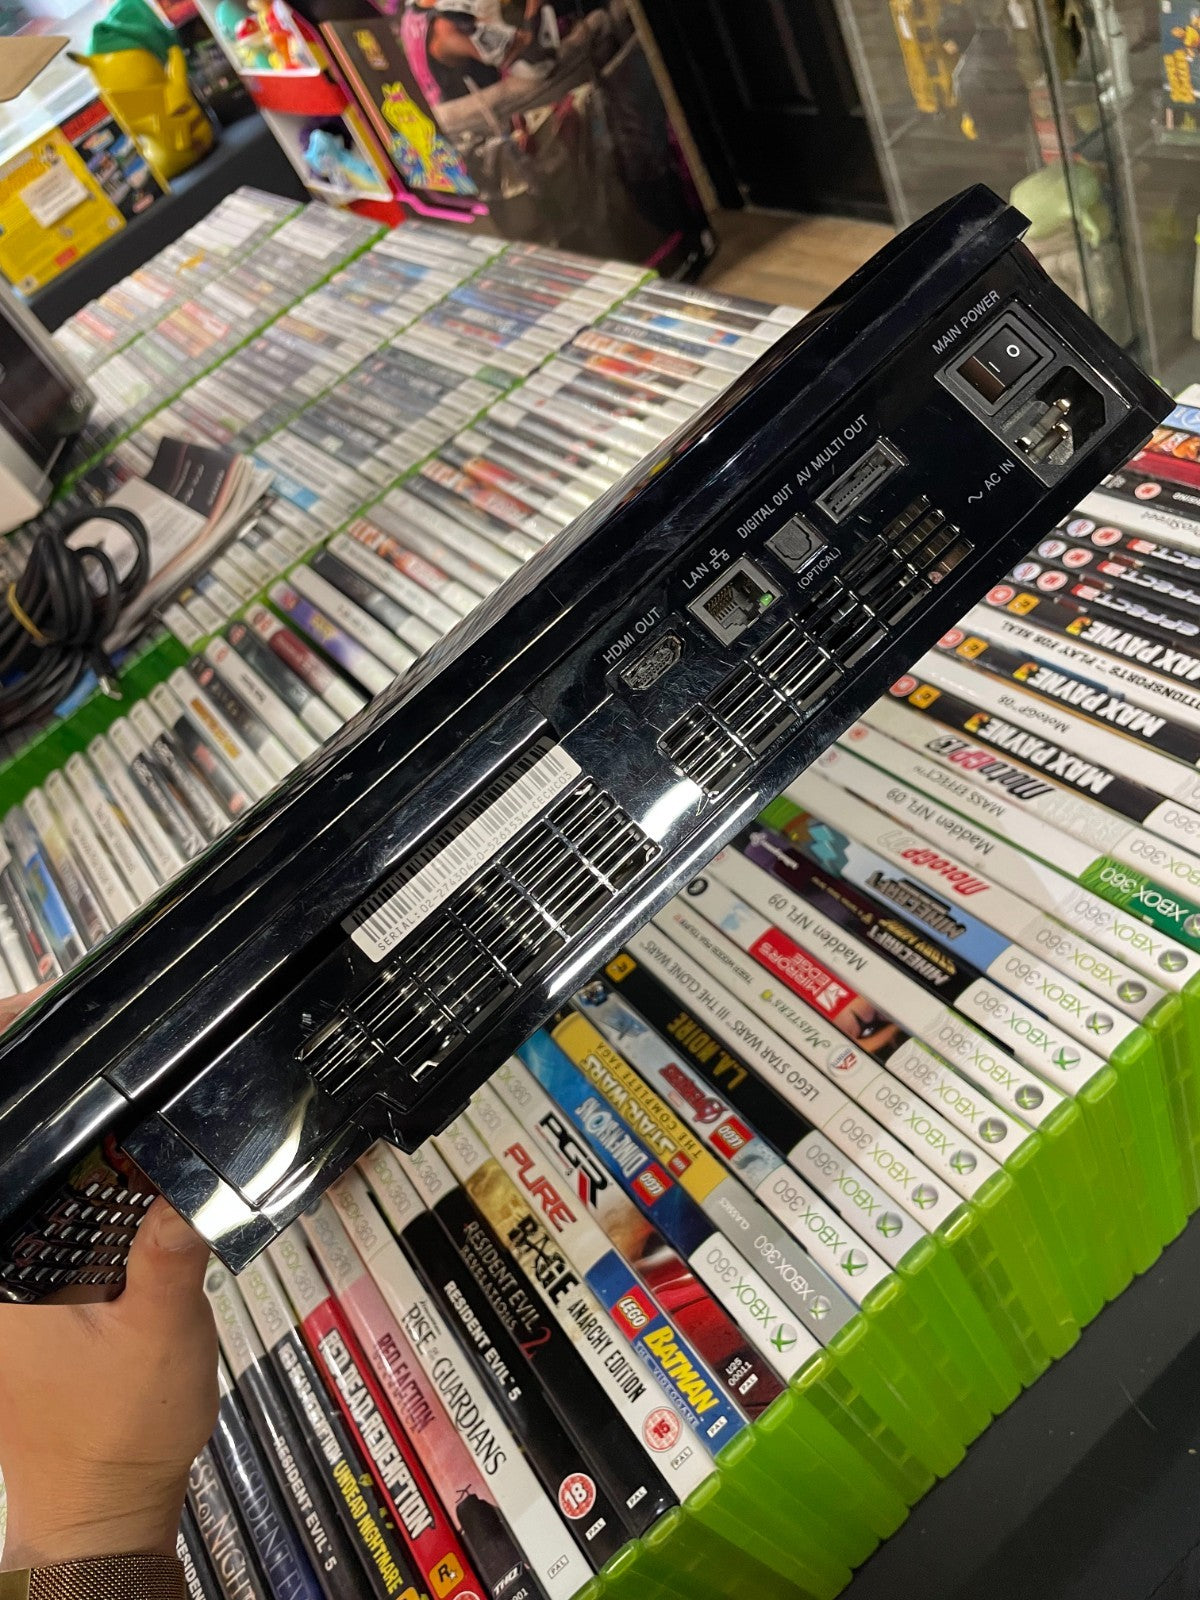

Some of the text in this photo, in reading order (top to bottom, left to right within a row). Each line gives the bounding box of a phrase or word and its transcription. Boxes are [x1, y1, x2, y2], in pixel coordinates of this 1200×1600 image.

[932, 290, 1000, 355] MAIN POWER
[796, 414, 868, 486] AV MULTI OUT
[983, 458, 1016, 492] AC IN
[737, 483, 794, 540] DIGITAL OUT
[682, 562, 710, 589] LAN
[797, 547, 842, 590] (OPTICAL)
[602, 607, 660, 664] HDMI OUT
[1064, 612, 1092, 636] 3
[1079, 619, 1163, 662] PAYNE
[1011, 658, 1166, 737] MAX PAYNE 3
[962, 710, 1115, 794] MAX PAYNE 3
[885, 785, 995, 856] Madden NFL 09
[967, 789, 1006, 818] MASS
[1127, 838, 1168, 867] 360
[767, 890, 788, 911] 09
[785, 904, 814, 930] NFL
[864, 868, 966, 944] MINECRAFT
[1097, 865, 1188, 925] XBOX 360
[810, 922, 868, 973] Madden
[865, 924, 949, 988] MINECRAFT
[1034, 926, 1122, 988] XBOX 360
[1072, 898, 1162, 958] XBOX 360
[666, 961, 702, 994] CLONE
[695, 988, 719, 1011] THE
[756, 940, 821, 996] MIRROR'S
[790, 950, 831, 987] EDGE
[1003, 956, 1090, 1019] XBOX 360
[715, 1005, 730, 1021] III
[971, 988, 1057, 1054] XBOX 360
[594, 1040, 622, 1070] SAGA
[665, 1010, 748, 1092] L.A. NOIRE
[759, 1045, 790, 1076] STAR
[937, 1023, 1020, 1092] XBOX 360
[577, 1053, 676, 1158] STAR WARS
[622, 1069, 678, 1131] COMPLETE
[785, 1068, 820, 1102] LEGO
[902, 1054, 982, 1123] XBOX 360
[573, 1095, 663, 1197] LEGO DIMENSIONS
[676, 1131, 702, 1158] THE
[716, 1121, 746, 1151] LEGO
[873, 1085, 953, 1154] XBOX 360
[539, 1111, 610, 1208] PGR
[802, 1143, 881, 1217] XBOX 360
[837, 1117, 916, 1188] XBOX 360
[501, 1142, 576, 1232] PURE
[770, 1177, 846, 1254] XBOX 360
[717, 1195, 814, 1301] XBOX 360 CLASSICS
[462, 1220, 553, 1359] RESIDENT EVIL 2
[507, 1214, 581, 1305] RAGE
[566, 1298, 613, 1354] ANARCHY
[603, 1350, 646, 1403] EDITION
[704, 1247, 778, 1328] XBOX 360
[317, 1329, 351, 1374] RED
[441, 1280, 491, 1349] RESIDENT
[506, 1386, 522, 1402] 5
[618, 1296, 719, 1414] LEGO BATMAN
[333, 1366, 375, 1422] DEAD
[400, 1302, 436, 1356] RISE
[428, 1356, 508, 1477] GUARDIANS
[653, 1419, 671, 1438] 15
[226, 1440, 294, 1574] RESIDENT
[271, 1435, 314, 1513] RESIDENT
[322, 1555, 338, 1572] 5
[357, 1413, 433, 1539] REDEMPTION
[564, 1483, 588, 1509] 18
[330, 1458, 368, 1520] UNDEAD
[355, 1514, 404, 1594] NIGHTMARE
